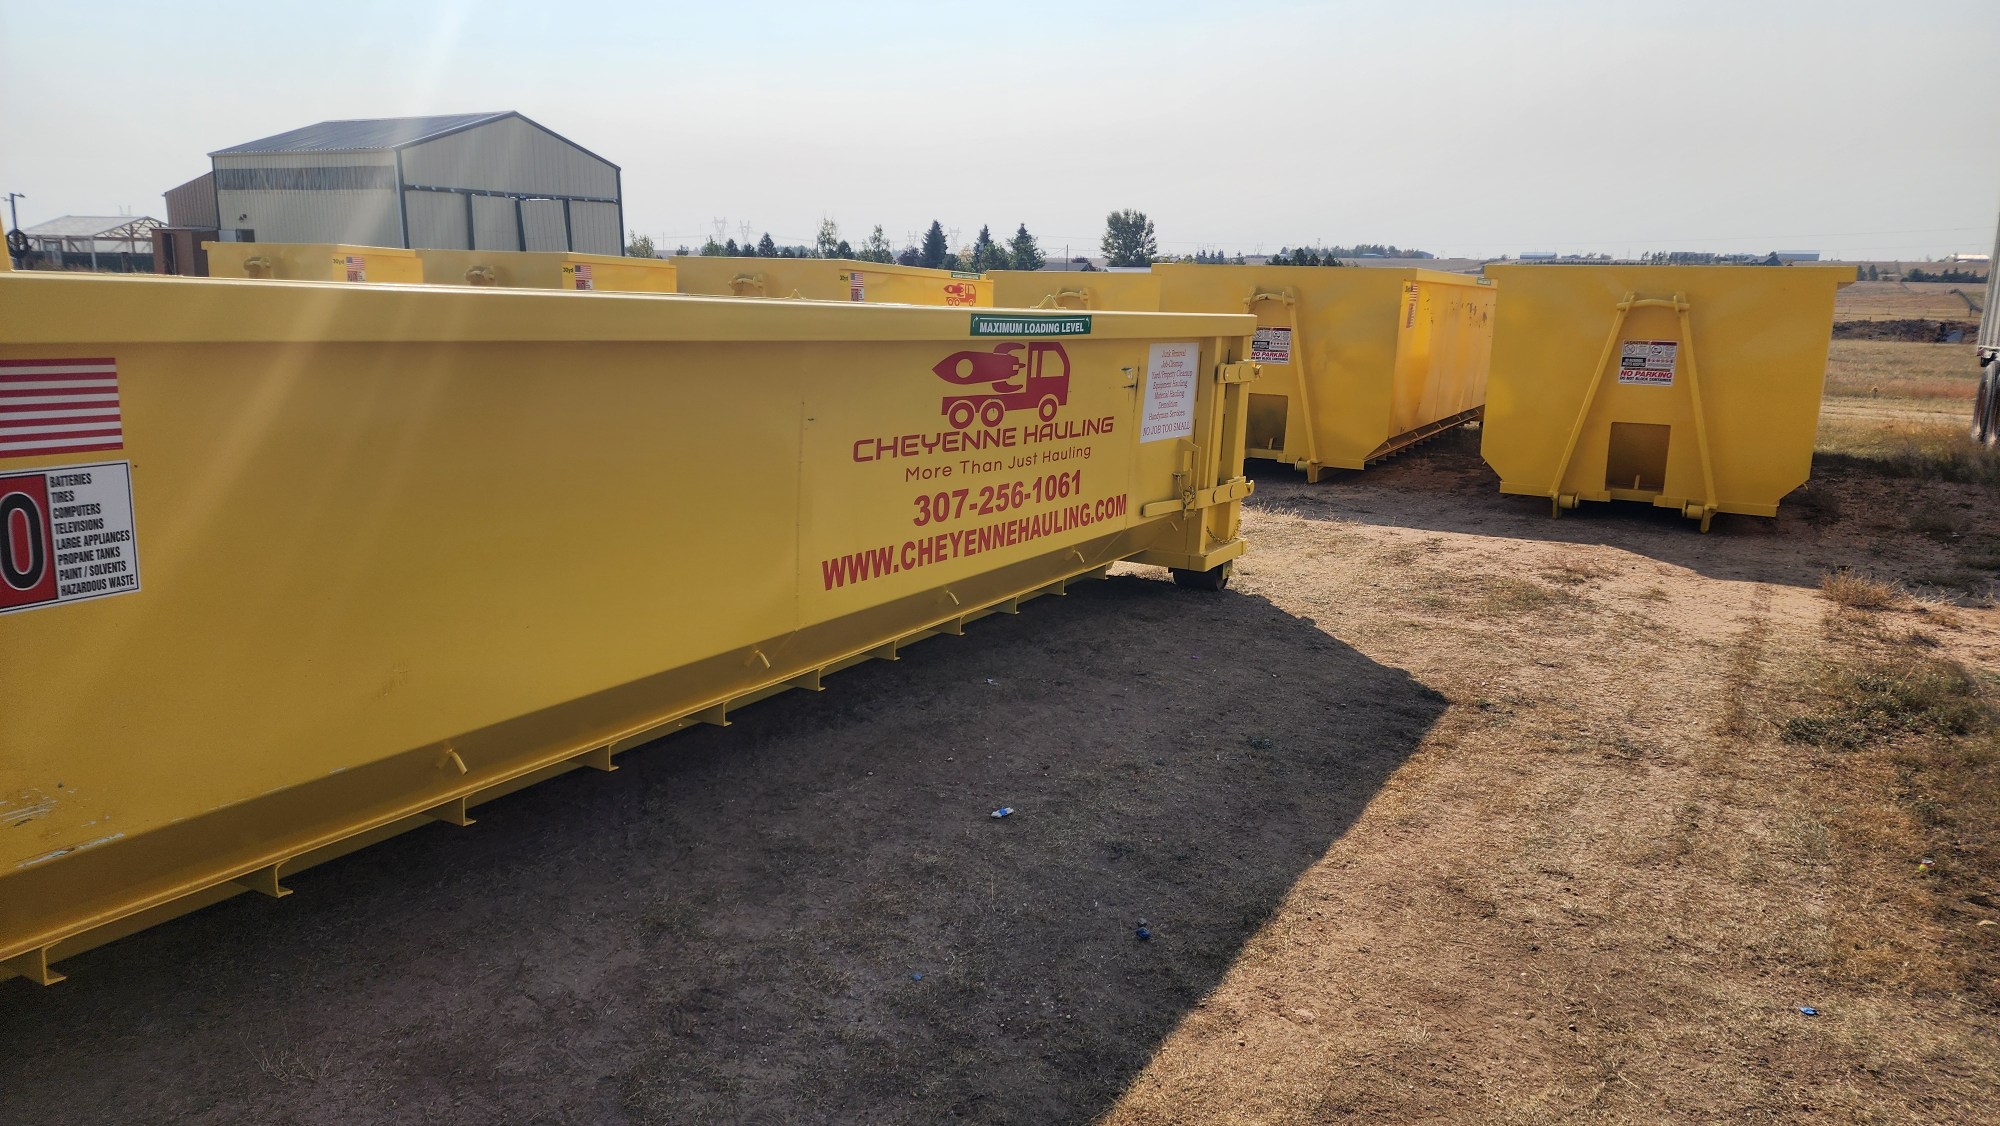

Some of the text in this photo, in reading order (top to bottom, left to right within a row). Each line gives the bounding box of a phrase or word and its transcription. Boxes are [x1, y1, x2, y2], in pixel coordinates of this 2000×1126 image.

[979, 322, 1084, 333] MAXIMUM LOADING LEVEL
[1635, 371, 1672, 379] PARKING
[1143, 421, 1191, 436] NO JOB TOO SMALL
[853, 416, 1115, 463] CHEYENNE HAULING
[905, 447, 1091, 482] More Than Just Hauling
[50, 473, 92, 488] BATTERIES
[51, 491, 75, 503] TIRES
[913, 470, 1082, 526] 307-256-1061
[53, 503, 101, 519] COMPUTERS
[54, 518, 104, 534] TELEVISIONS
[56, 530, 130, 550] LARGE APPLIANCES
[822, 493, 1127, 591] WWW.CHEYENNEHAULING.COM
[57, 546, 120, 565] PROPANE TANKS
[59, 567, 82, 581] PAINT
[89, 561, 127, 576] SOLVENTS
[60, 574, 135, 596] HAZARDOUS WASTE
